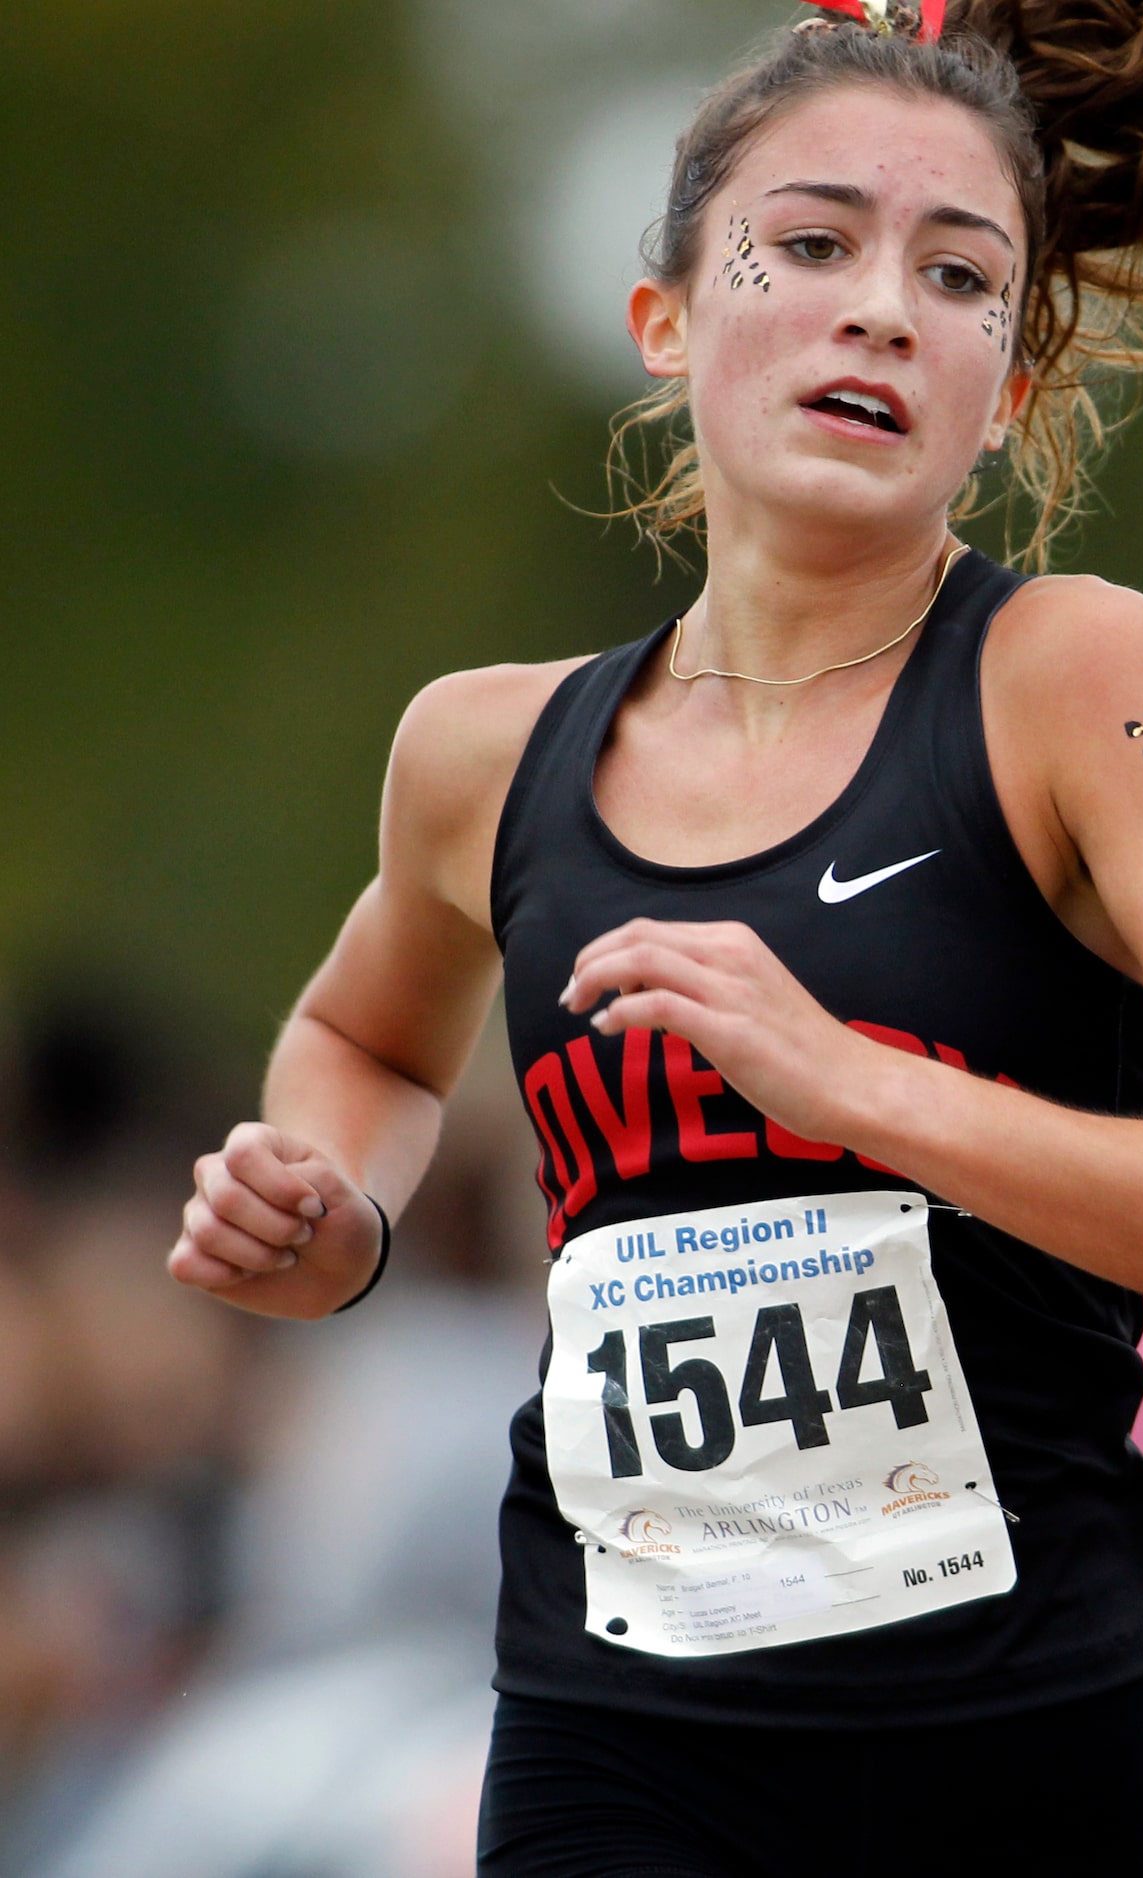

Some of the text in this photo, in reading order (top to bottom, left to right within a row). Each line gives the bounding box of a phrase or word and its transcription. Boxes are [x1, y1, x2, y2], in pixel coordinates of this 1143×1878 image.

[616, 1208, 829, 1263] UIL Region II
[589, 1246, 875, 1310] XC Championship
[586, 1284, 933, 1479] 1544
[674, 1477, 864, 1519] The University of Texas
[703, 1497, 852, 1541] ARLINGTON
[881, 1491, 952, 1517] MAVERICKS
[901, 1501, 942, 1515] ARLINGTON
[780, 1573, 806, 1588] 1544
[903, 1550, 985, 1588] No. 1544
